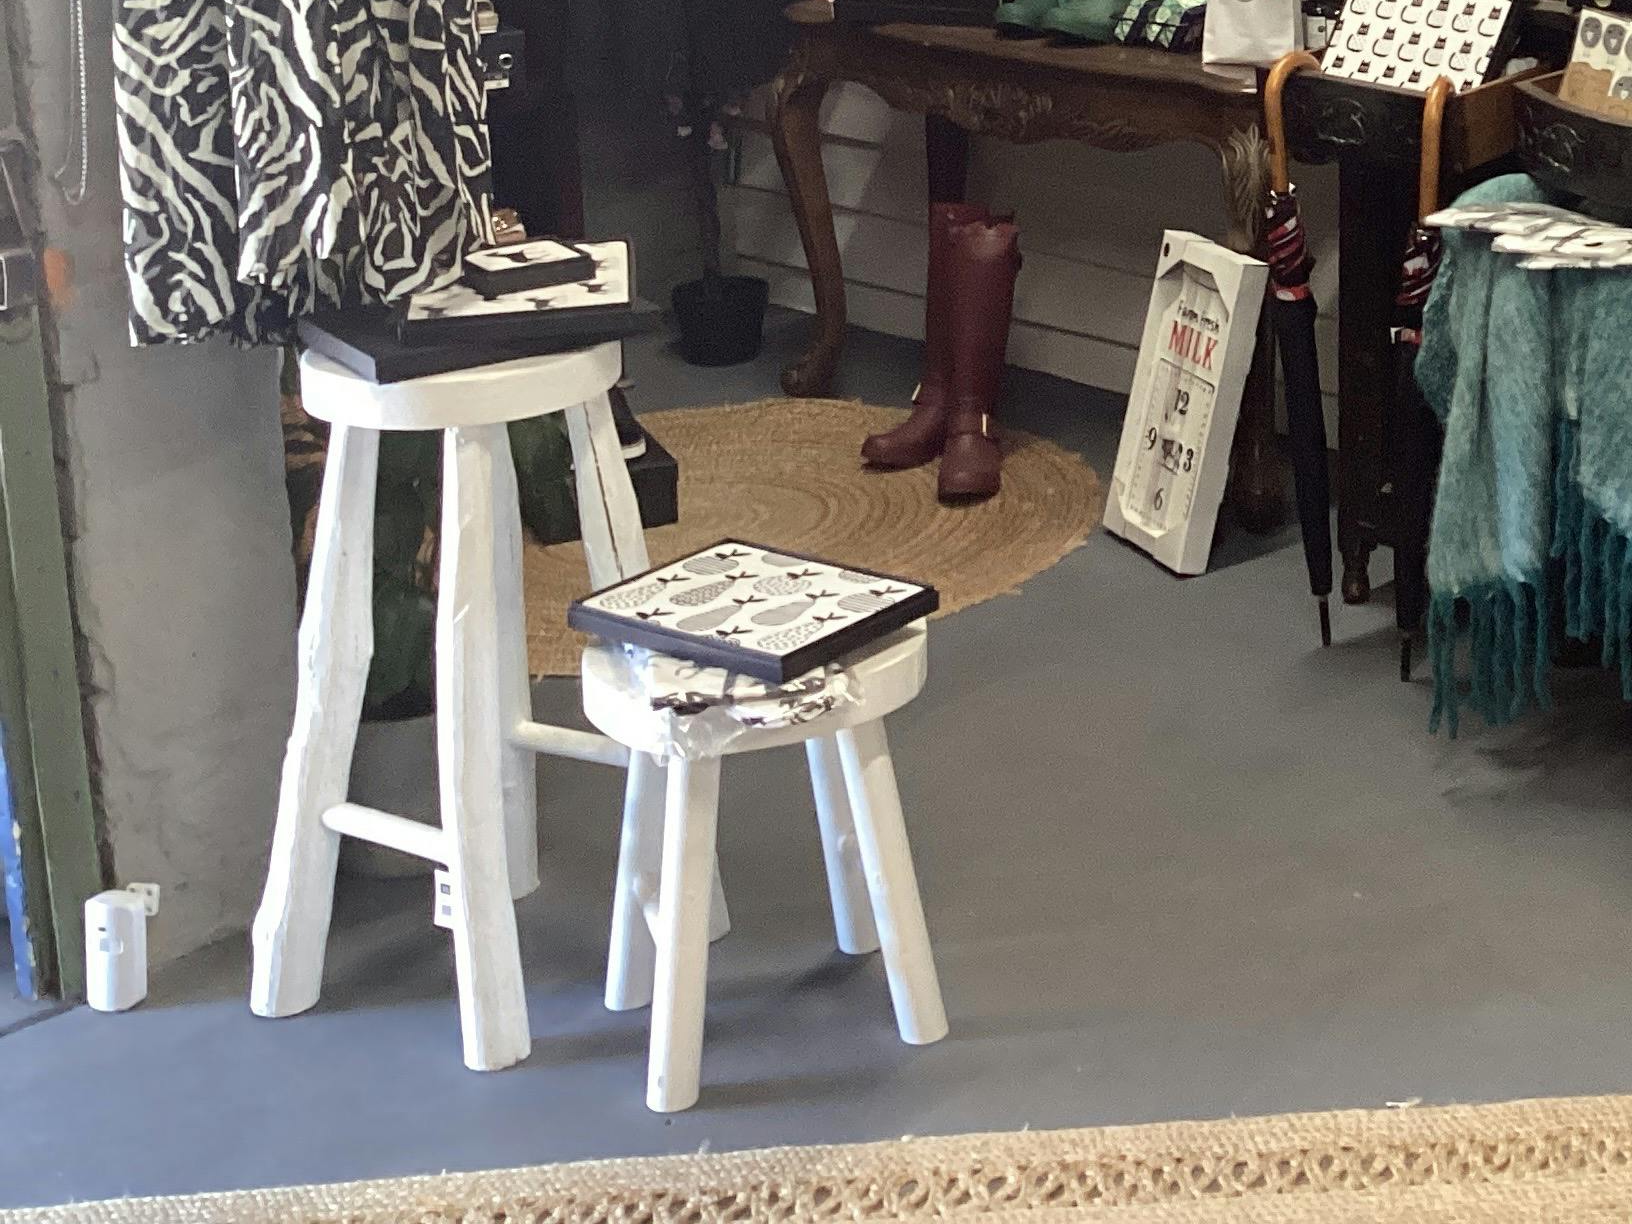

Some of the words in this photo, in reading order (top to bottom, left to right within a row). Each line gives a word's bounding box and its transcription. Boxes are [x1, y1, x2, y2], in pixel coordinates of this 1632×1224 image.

[1167, 319, 1219, 371] MILK
[1173, 387, 1191, 416] 12
[1147, 426, 1158, 451] 9
[1182, 447, 1195, 473] 3
[1153, 487, 1165, 511] 6
